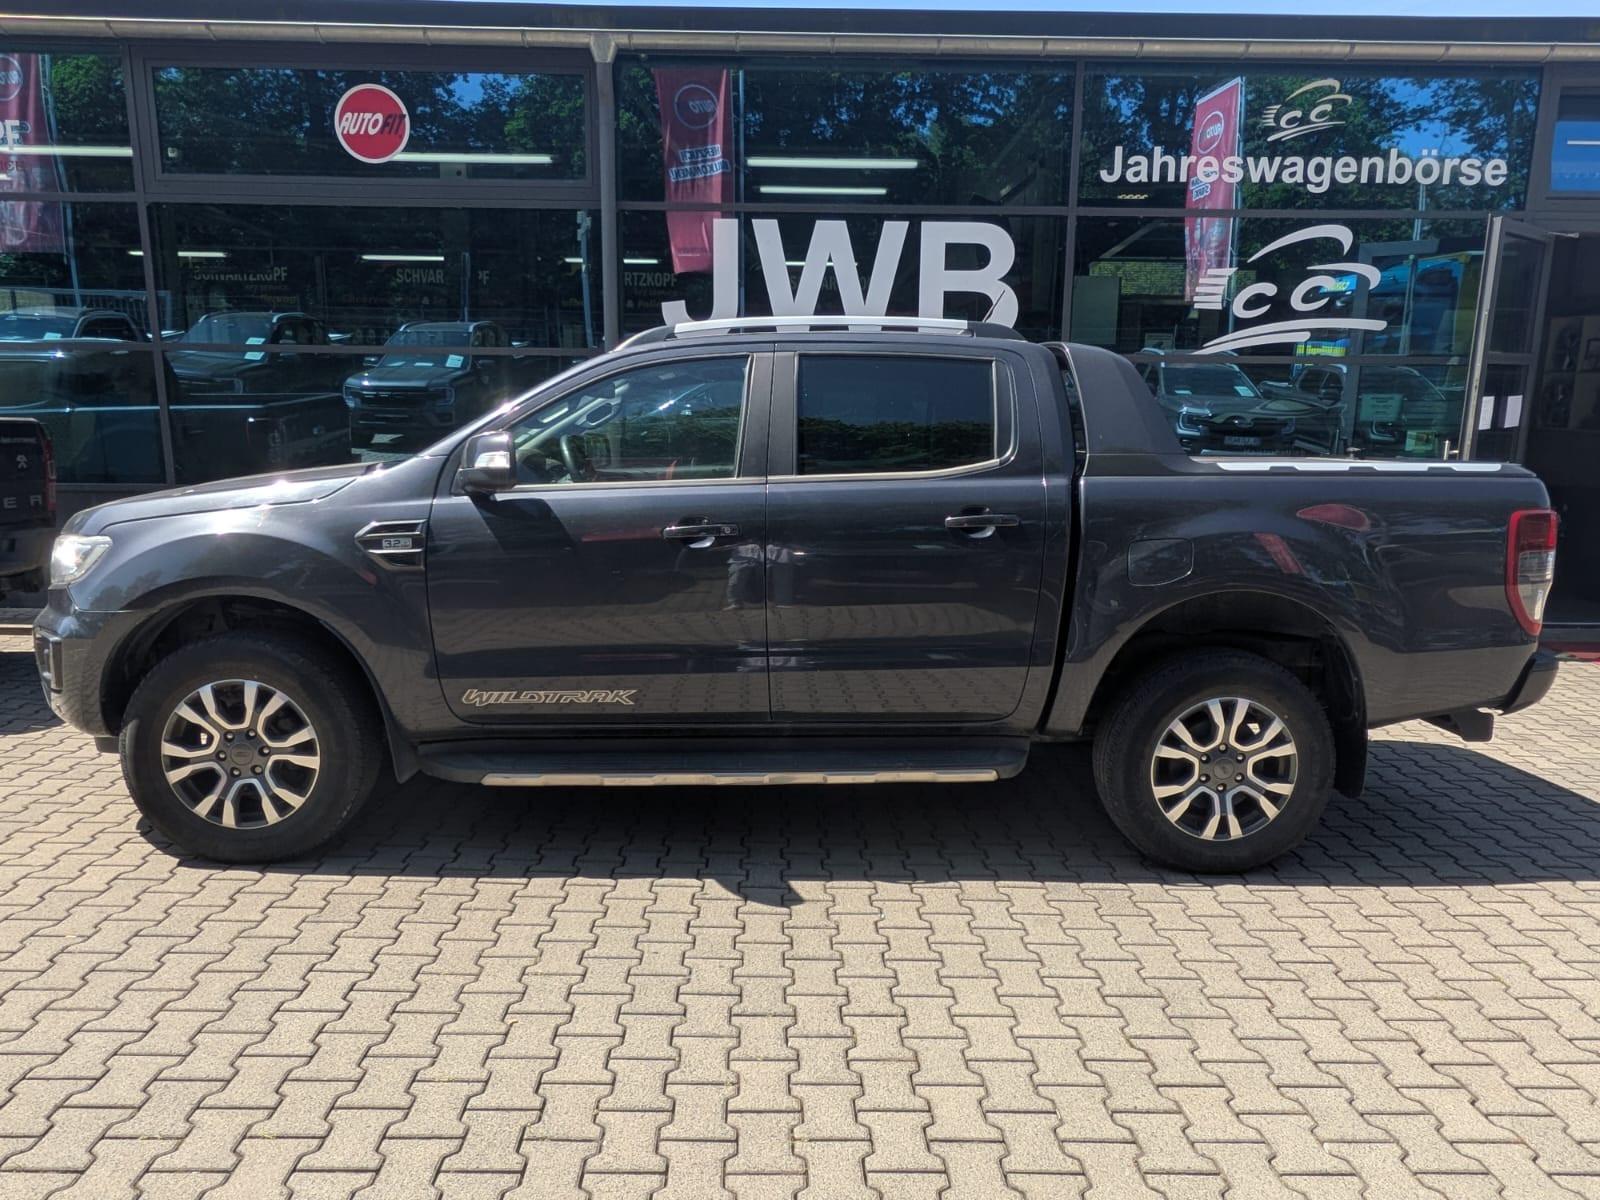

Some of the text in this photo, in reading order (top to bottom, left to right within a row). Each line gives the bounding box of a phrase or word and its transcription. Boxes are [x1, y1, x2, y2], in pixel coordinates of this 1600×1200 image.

[1100, 146, 1508, 193] Jahreswagenbörse
[661, 218, 1019, 330] JWB
[461, 688, 637, 707] WILDTRAK
